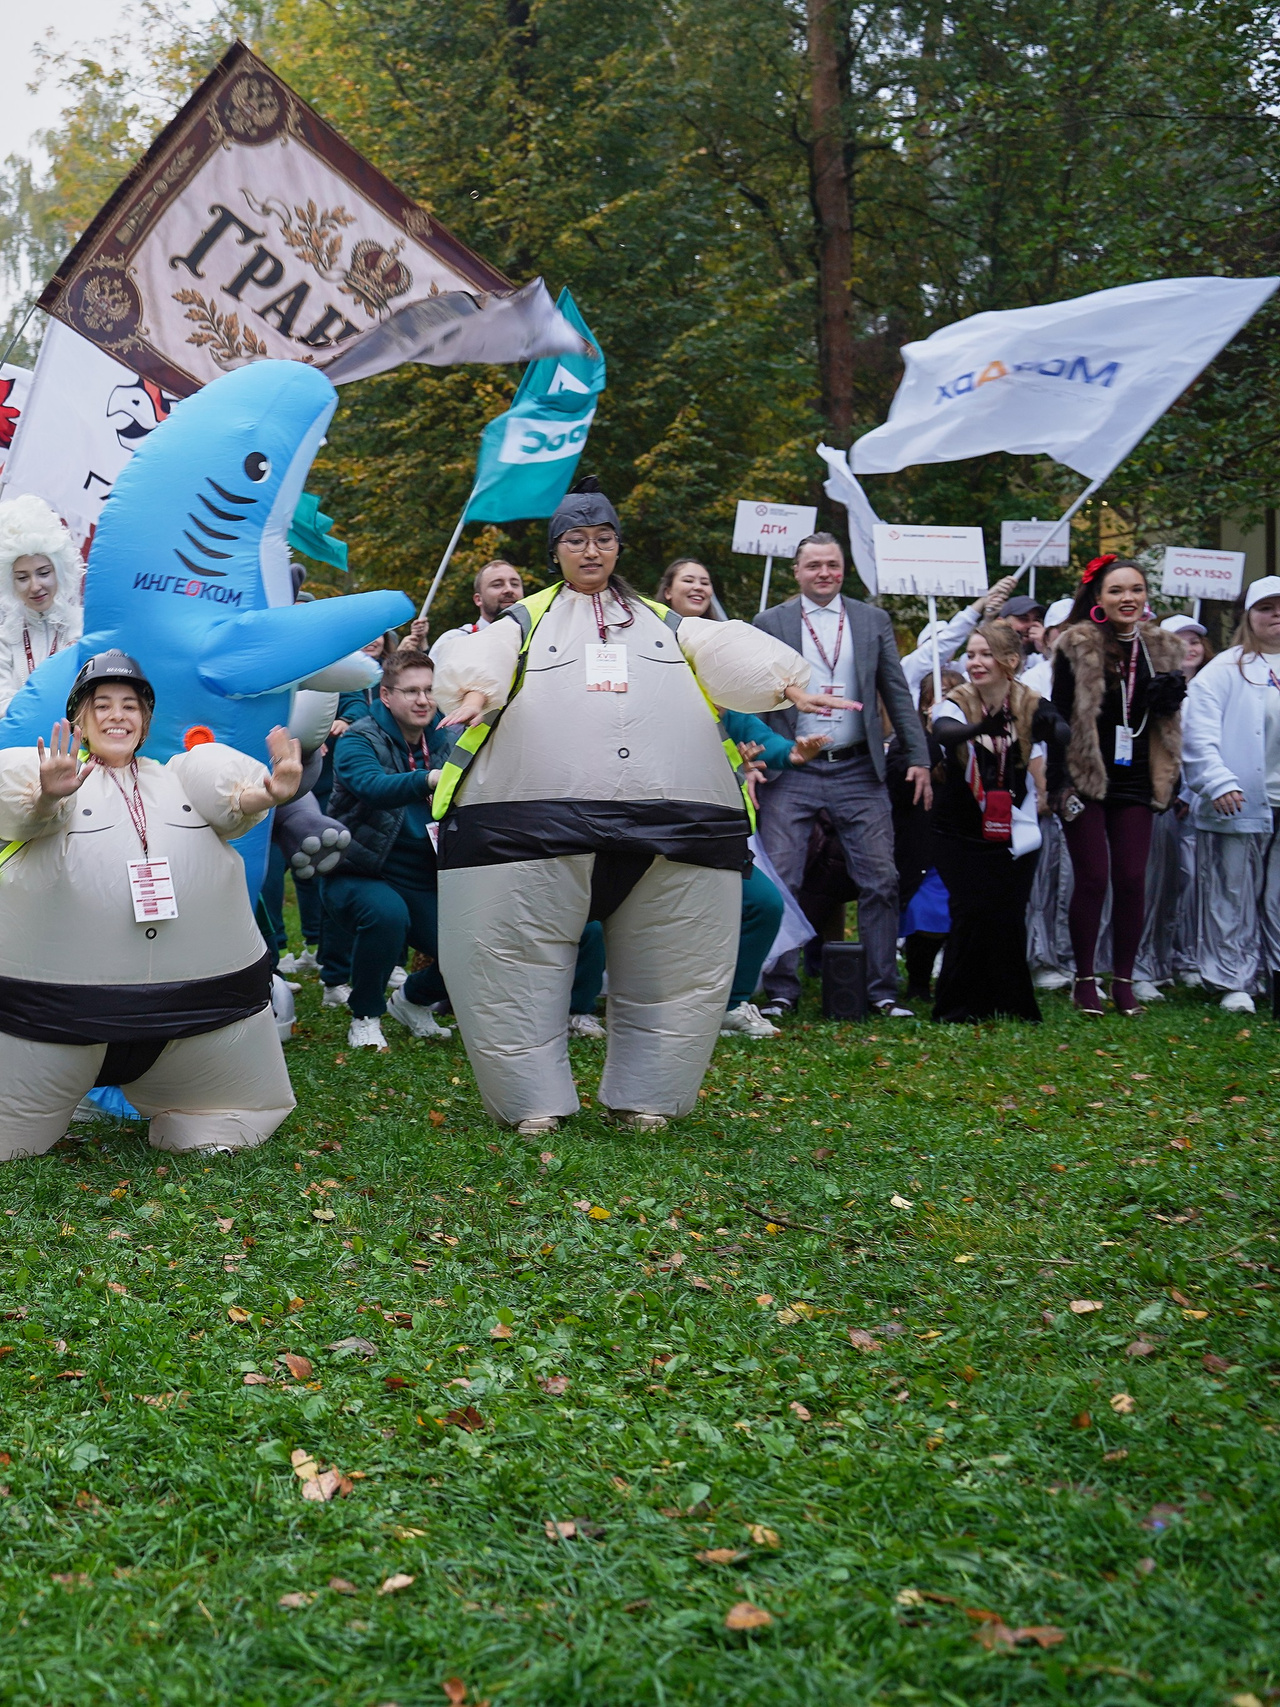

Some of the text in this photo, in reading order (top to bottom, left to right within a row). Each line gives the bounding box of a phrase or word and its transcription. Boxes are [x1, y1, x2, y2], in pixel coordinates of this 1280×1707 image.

[760, 523, 787, 535] ДГИ
[1173, 566, 1232, 580] ОСК 1520
[132, 572, 243, 607] ИНГЕОКОМ
